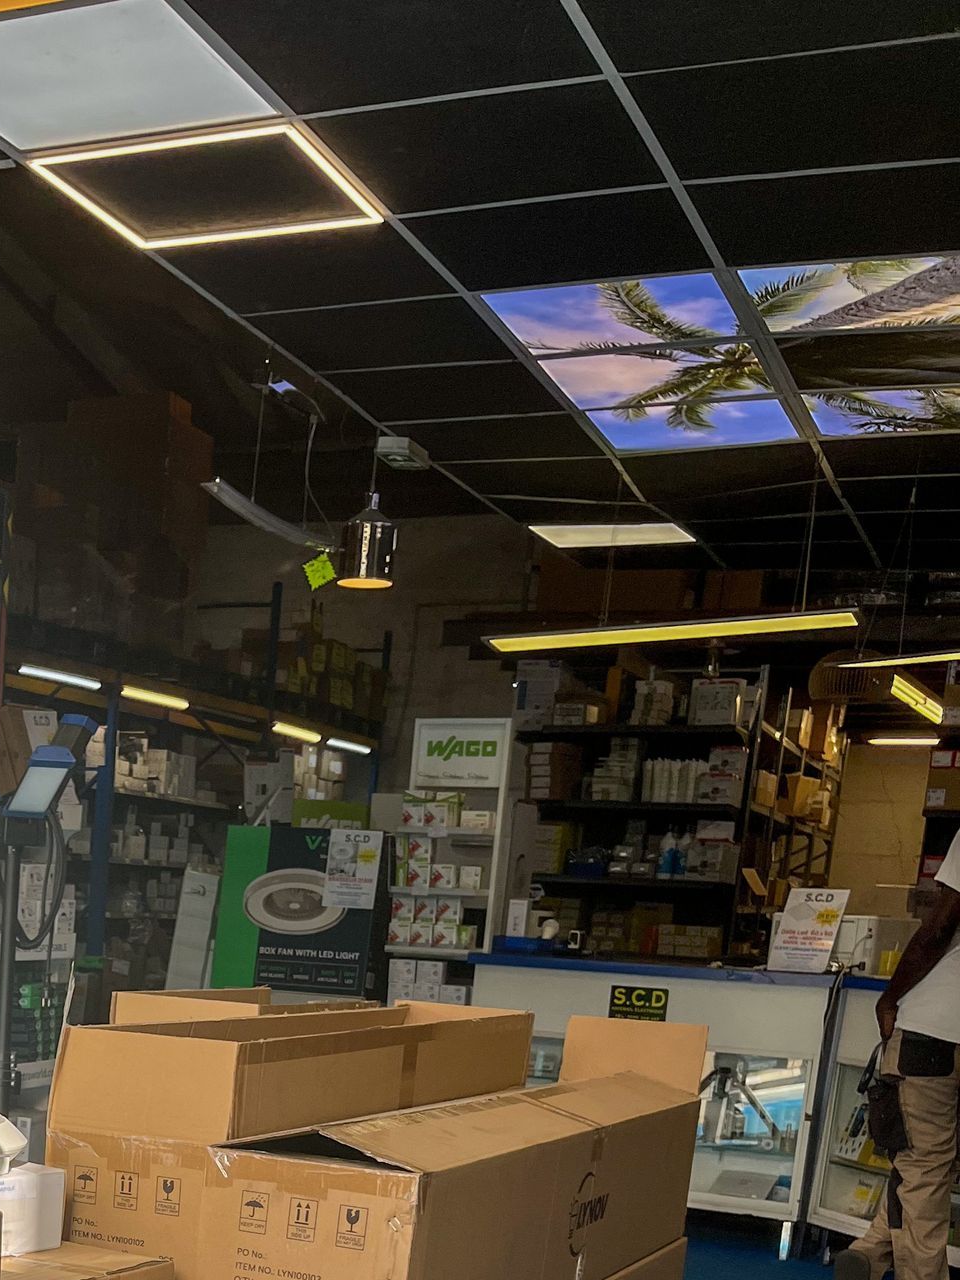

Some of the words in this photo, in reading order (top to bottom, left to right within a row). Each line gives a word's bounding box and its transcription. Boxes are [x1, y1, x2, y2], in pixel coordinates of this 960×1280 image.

[426, 735, 498, 761] WAGO
[259, 946, 276, 955] BOX
[277, 947, 293, 956] FAN
[295, 948, 317, 957] WITH
[319, 950, 334, 958] LED
[335, 952, 360, 960] LIGHT
[613, 987, 666, 1008] S.C.D
[72, 1216, 83, 1225] PO
[71, 1229, 90, 1238] ITEM
[107, 1234, 145, 1247] LYN100102
[237, 1247, 249, 1256] PO
[235, 1261, 256, 1272] ITEM
